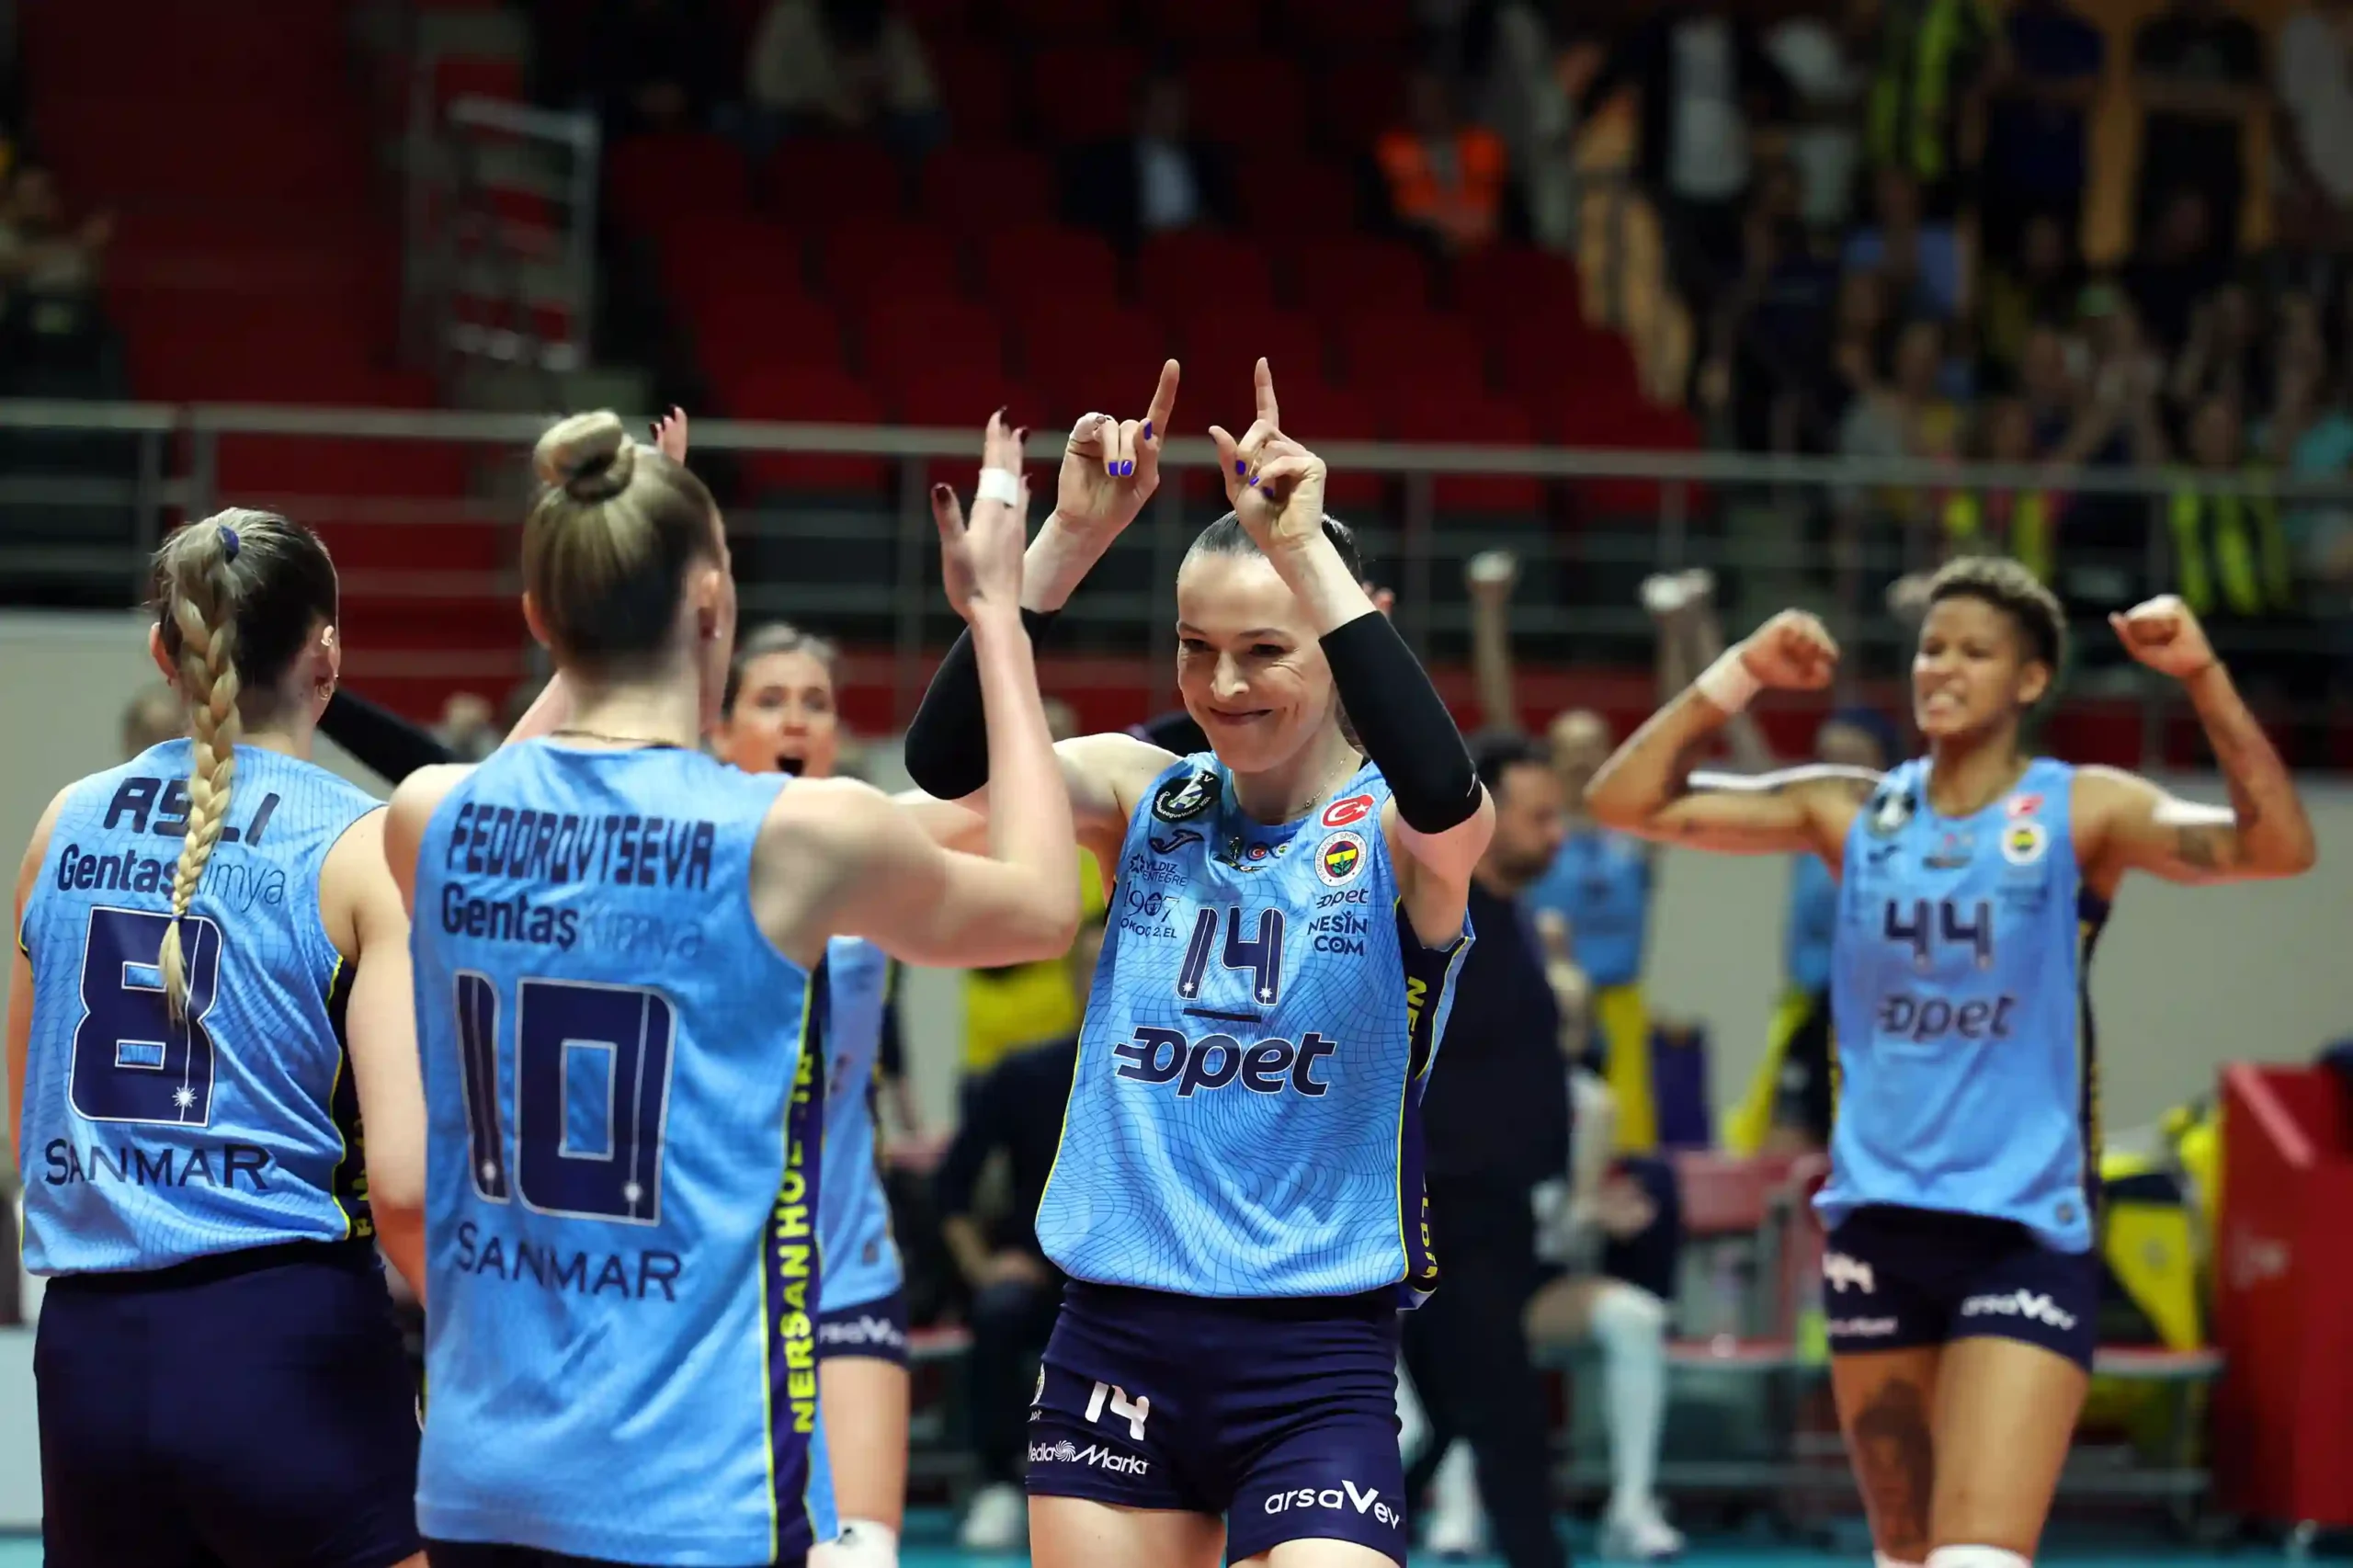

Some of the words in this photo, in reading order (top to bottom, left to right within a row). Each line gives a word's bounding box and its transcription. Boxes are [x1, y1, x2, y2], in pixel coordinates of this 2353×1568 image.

[196, 852, 286, 914] imya
[447, 801, 715, 892] FEDOROVTSEVA
[1142, 870, 1188, 887] ENTEGRE
[441, 881, 579, 953] Gentaş
[1313, 935, 1364, 957] COM
[1885, 898, 1994, 972] 44
[1175, 904, 1286, 1006] 14
[69, 903, 223, 1127] 8
[452, 969, 677, 1227] 10
[44, 1138, 272, 1190] SANMAR
[457, 1221, 682, 1302] SANMAR
[1085, 1381, 1150, 1441] 14
